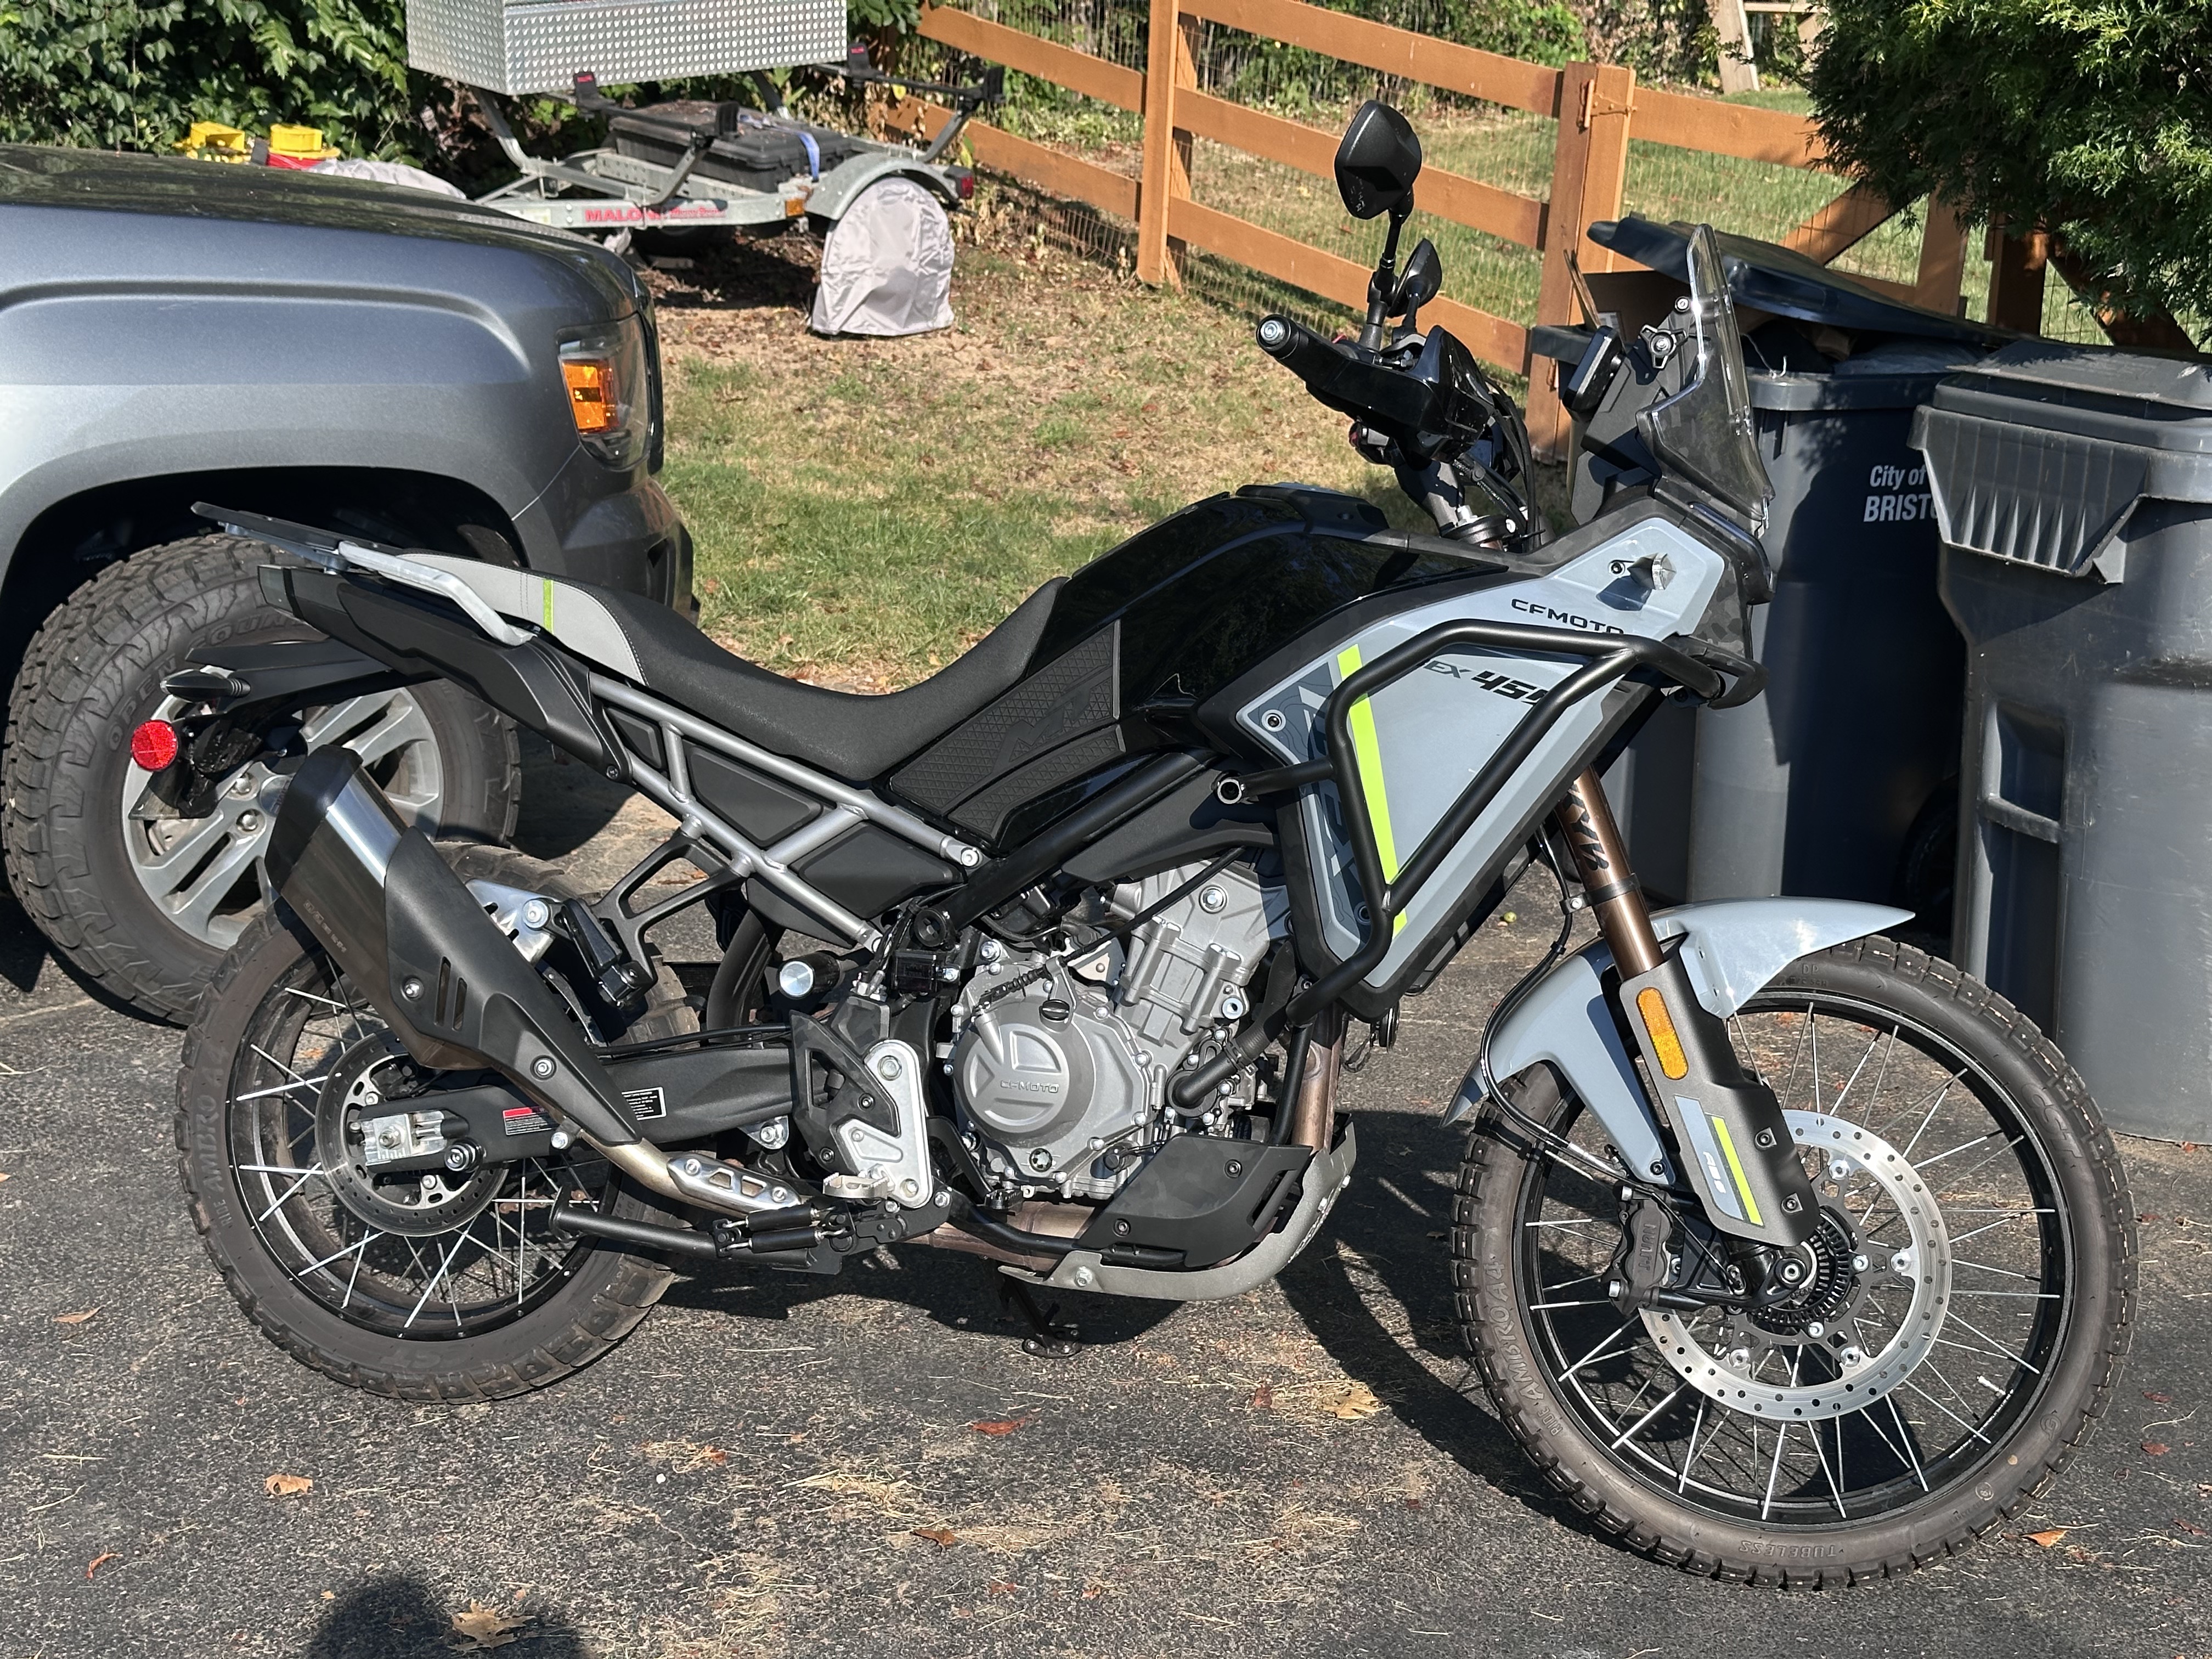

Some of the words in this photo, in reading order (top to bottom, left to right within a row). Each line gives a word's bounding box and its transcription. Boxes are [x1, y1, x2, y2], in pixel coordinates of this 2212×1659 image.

[585, 208, 667, 221] MALO
[1870, 465, 1905, 490] City
[1908, 464, 1927, 486] of
[188, 610, 306, 649] COUN
[1000, 1079, 1059, 1093] CFMOTO
[196, 1094, 224, 1193] AMBRO
[1703, 1151, 1726, 1194] ABS
[1638, 1223, 1657, 1273] J.JUAN
[1483, 1262, 1509, 1302] A4
[1489, 1306, 1545, 1400] AMBRO
[1537, 1407, 1564, 1436] RIDE
[1738, 1540, 1837, 1559] TUBELESS
